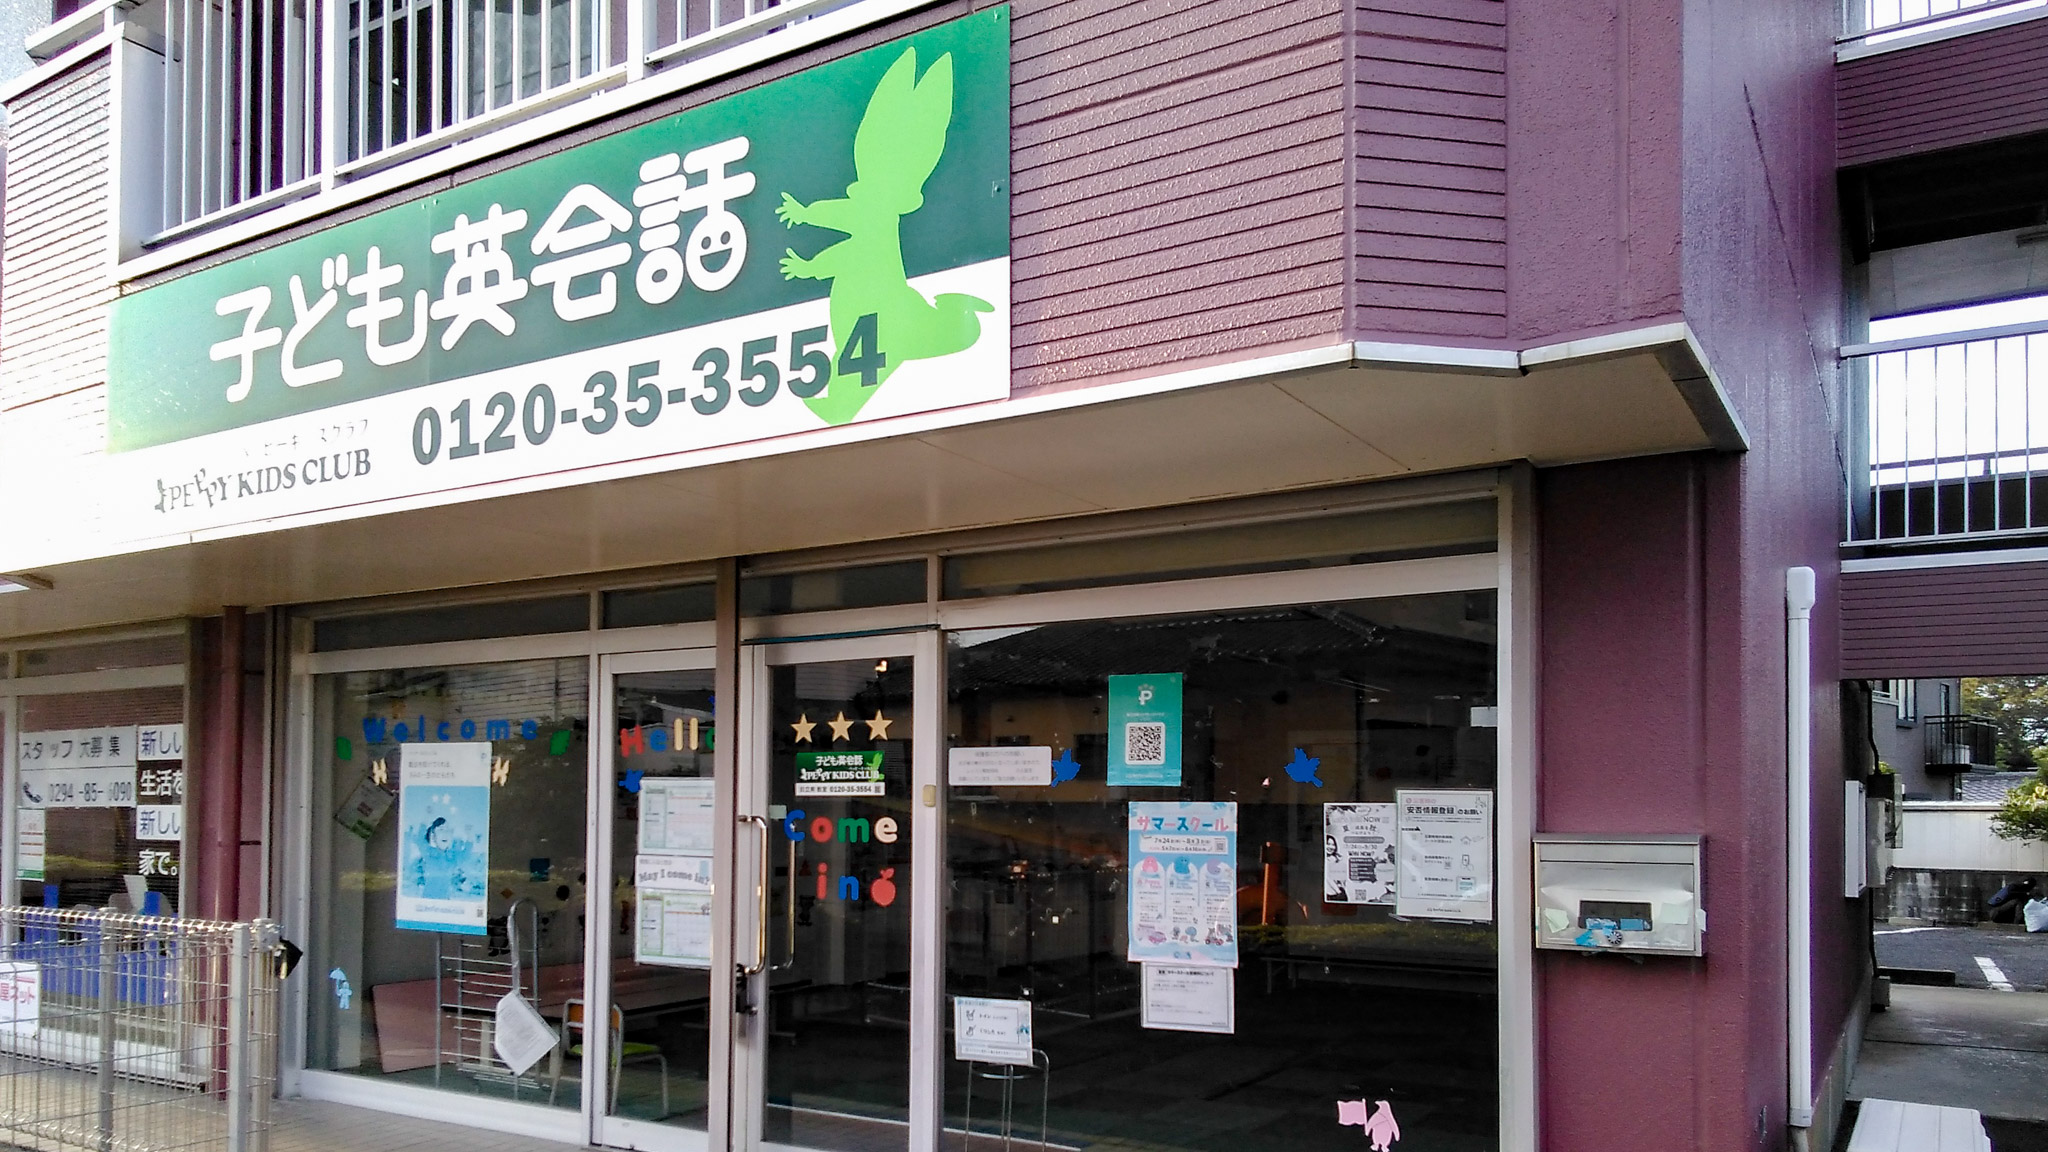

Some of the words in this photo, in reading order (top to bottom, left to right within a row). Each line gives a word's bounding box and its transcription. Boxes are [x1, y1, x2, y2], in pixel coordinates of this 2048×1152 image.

[210, 136, 757, 403] 子ども英会話
[411, 312, 887, 466] 0120-35-3554
[237, 463, 297, 499] KIDS
[302, 448, 372, 486] CLUB
[362, 714, 539, 744] Welcome
[816, 754, 863, 766] 子ども英会話
[832, 771, 855, 780] KIDS
[855, 770, 880, 780] CLUB
[784, 810, 898, 843] Come
[1137, 816, 1229, 832] サマースクール
[138, 849, 178, 876] 家で。
[817, 862, 859, 900] in
